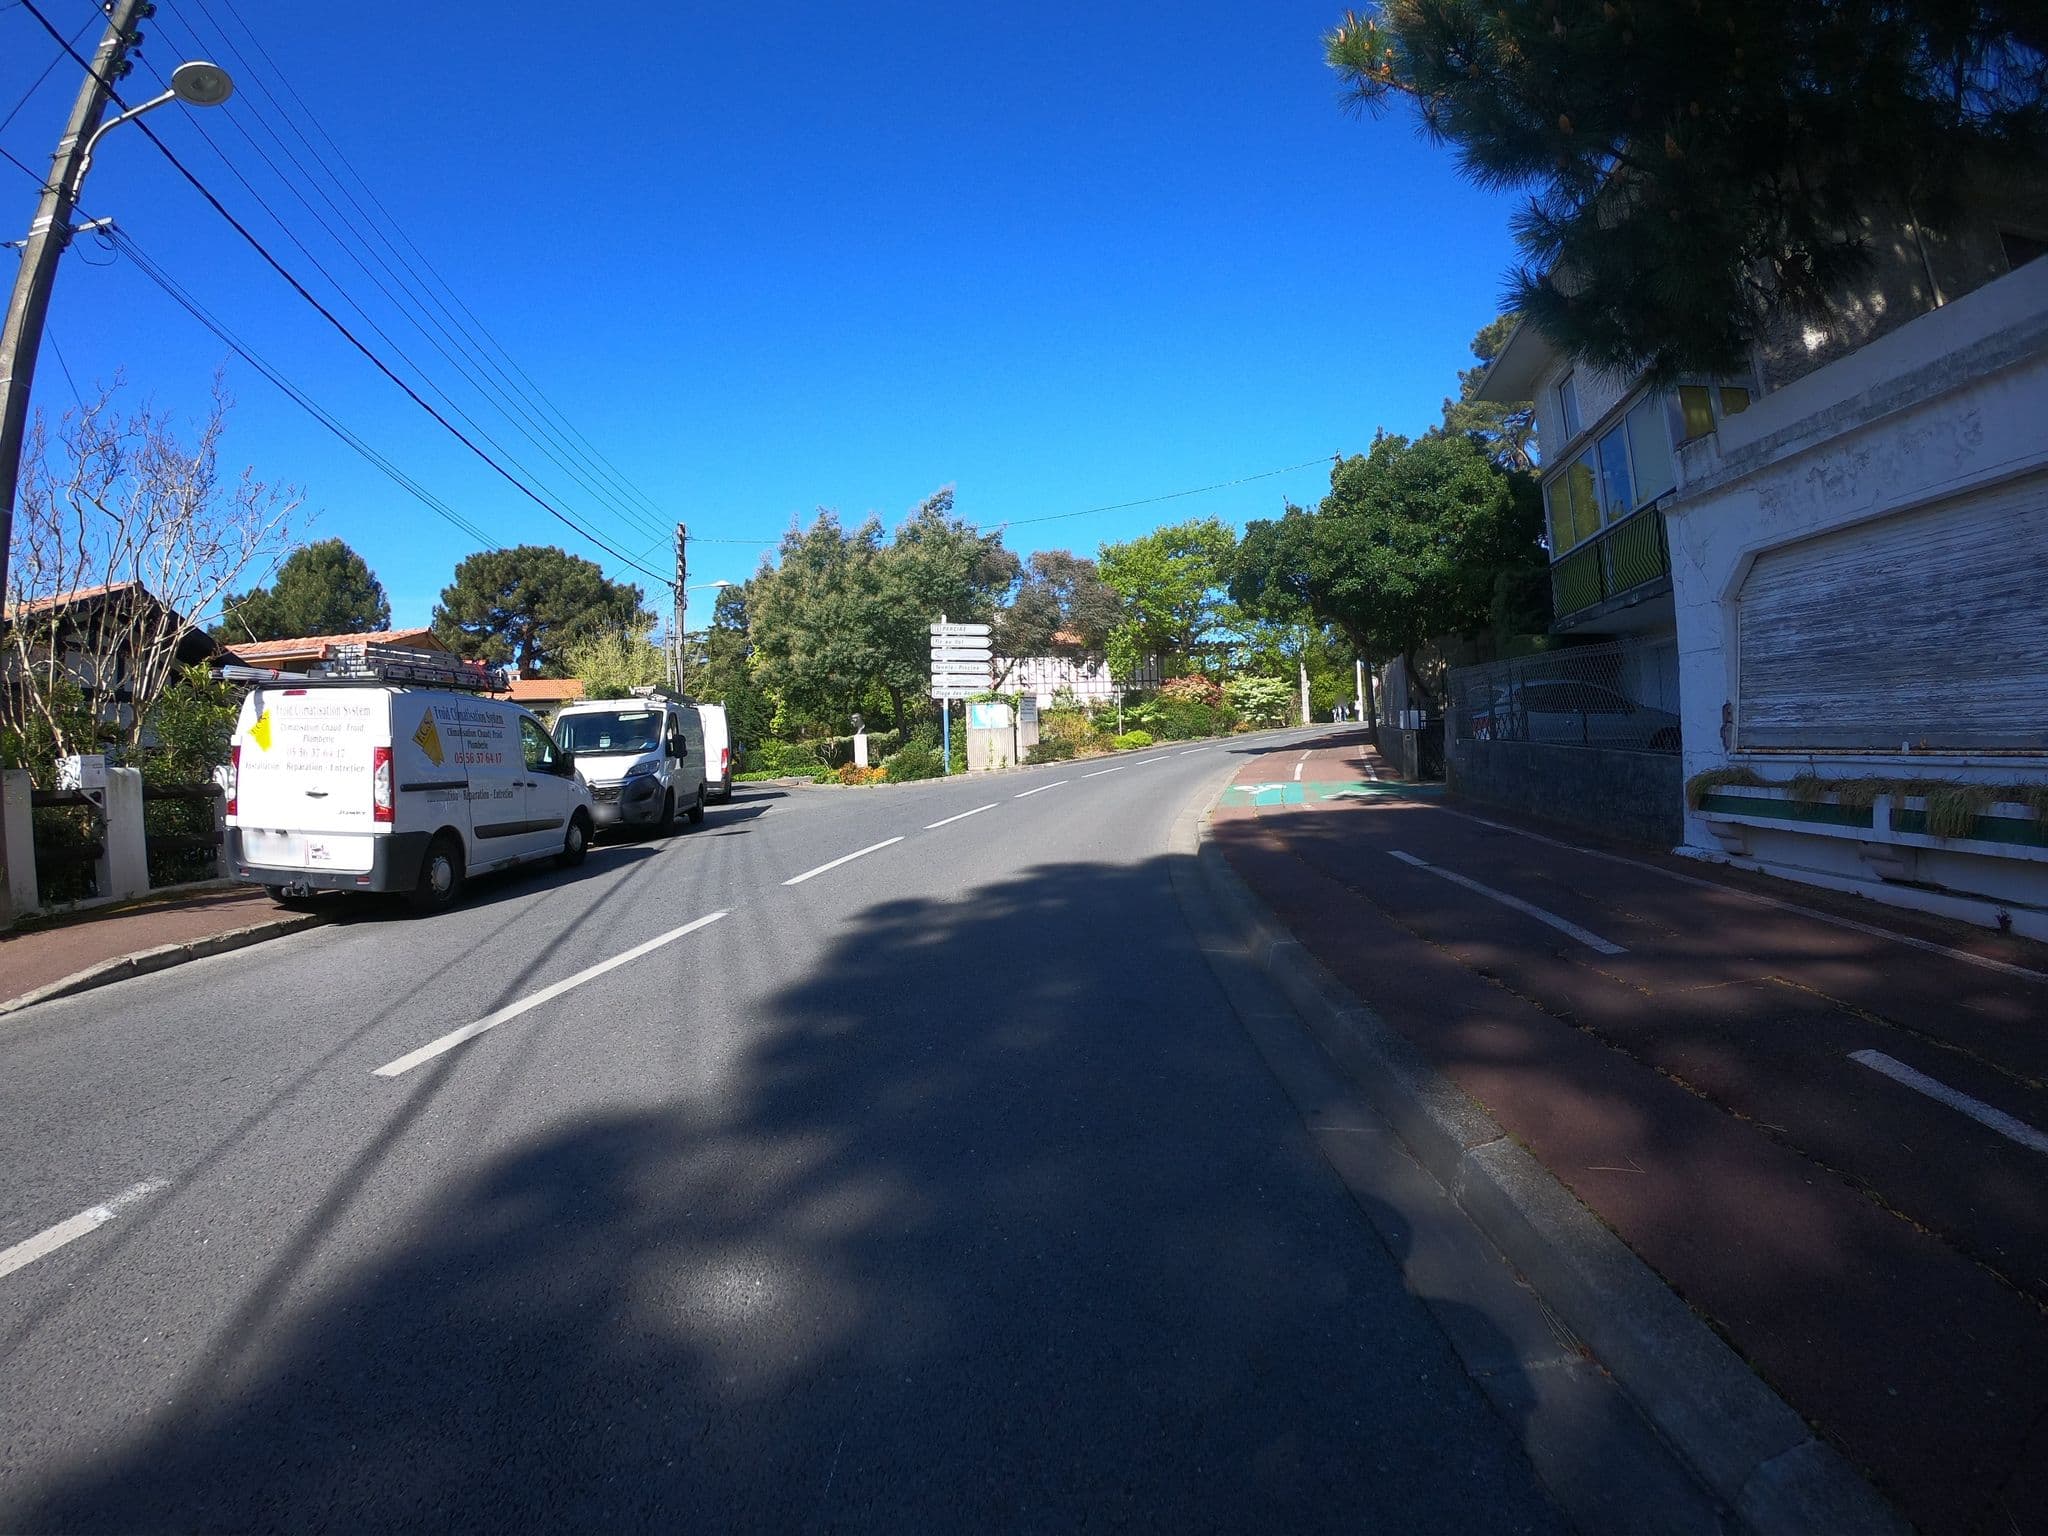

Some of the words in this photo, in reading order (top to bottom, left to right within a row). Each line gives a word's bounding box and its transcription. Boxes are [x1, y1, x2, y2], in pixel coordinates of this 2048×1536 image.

[342, 704, 370, 718] System
[455, 752, 464, 764] 05
[465, 752, 475, 764] 56
[476, 752, 484, 764] 37
[485, 752, 494, 764] 64
[495, 752, 503, 764] 17
